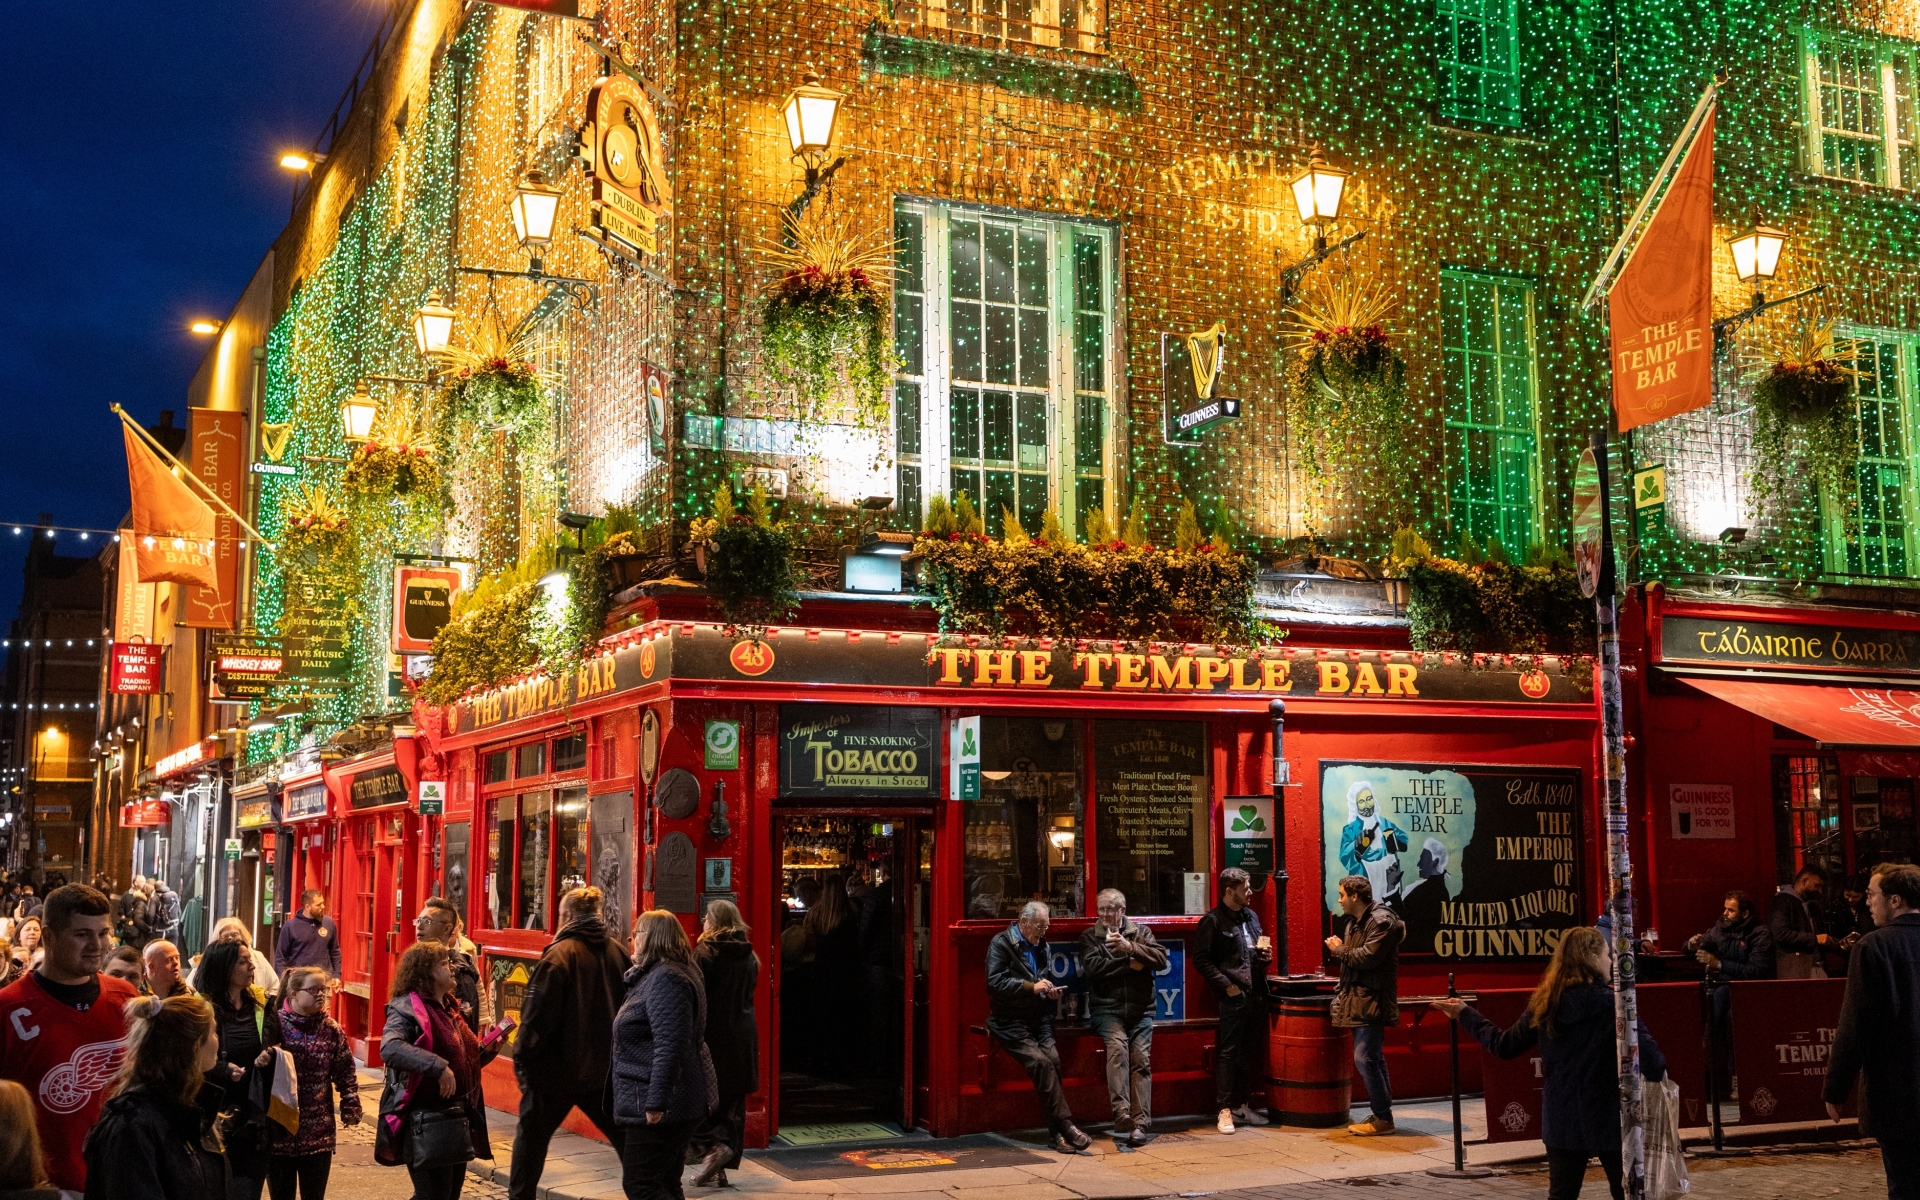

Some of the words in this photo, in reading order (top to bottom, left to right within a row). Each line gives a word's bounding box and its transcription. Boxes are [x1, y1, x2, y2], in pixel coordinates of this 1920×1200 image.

[600, 92, 612, 130] THE
[610, 81, 649, 120] TEMPLE
[648, 123, 659, 167] BAR
[613, 191, 646, 222] DUBLIN
[606, 213, 624, 234] LIVE
[627, 227, 652, 249] MUSIC
[1641, 320, 1678, 344] THE
[1619, 328, 1702, 373] TEMPLE
[1636, 361, 1678, 390] BAR
[1180, 402, 1219, 429] GUINNESS
[203, 442, 218, 477] BAR
[253, 463, 296, 474] GUINNESS
[222, 480, 232, 499] CO.
[166, 530, 197, 540] THE
[165, 552, 203, 566] BAR
[123, 582, 132, 624] TRADING
[410, 599, 445, 607] GUINNESS
[121, 626, 129, 641] CO.
[128, 646, 147, 654] THE
[236, 648, 269, 656] TEMPLE
[289, 650, 311, 658] LIVE
[313, 650, 344, 659] MUSIC
[118, 655, 156, 665] TEMPLE
[222, 658, 259, 670] WHISKEY
[259, 659, 282, 670] SHOP
[301, 660, 331, 668] DAILY
[125, 665, 146, 673] BAR
[227, 673, 276, 681] DISTILLERY
[929, 648, 1053, 688] THE
[1073, 652, 1293, 693] TEMPLE
[1316, 660, 1419, 697] BAR
[474, 697, 501, 727] THE
[506, 671, 570, 718] TEMPLE
[577, 658, 616, 699] BAR
[1523, 676, 1543, 692] 48
[787, 714, 851, 740] Importers
[844, 736, 867, 745] FINE
[869, 736, 917, 746] SMOKING
[1111, 740, 1166, 757] TEMPLE
[1170, 742, 1196, 759] BAR
[804, 741, 918, 782] TOBACCO
[1154, 755, 1169, 763] 1840
[828, 775, 870, 786] Always
[877, 776, 887, 785] in
[892, 775, 926, 786] Stock
[1119, 772, 1155, 780] Traditional
[1157, 772, 1174, 780] Food
[354, 781, 365, 800] THE
[365, 776, 387, 798] TEMPLE
[386, 773, 401, 793] BAR
[1131, 783, 1150, 791] Plate,
[1151, 783, 1176, 791] Cheese
[1409, 778, 1446, 797] THE
[1544, 783, 1573, 806] 1840
[1100, 794, 1118, 802] Fresh
[1120, 795, 1148, 804] Oysters,
[1149, 795, 1176, 803] Smoked
[1177, 795, 1203, 803] Salmon
[1672, 787, 1731, 804] GUINNESS
[1108, 806, 1147, 814] Charcuterie
[1149, 806, 1171, 814] Meats,
[1391, 796, 1464, 816] TEMPLE
[1695, 808, 1702, 816] IS
[1705, 807, 1729, 816] GOOD
[1118, 817, 1145, 825] Toasted
[1146, 817, 1185, 825] Sandwiches
[1411, 815, 1448, 834] BAR
[1537, 812, 1572, 835] THE
[1695, 818, 1711, 827] FOR
[1714, 818, 1730, 827] YOU
[1117, 828, 1130, 836] Hot
[1131, 828, 1150, 836] Roast
[1152, 828, 1169, 836] Beef
[1169, 828, 1187, 836] Rolls
[1495, 836, 1574, 862] EMPEROR
[1553, 863, 1573, 887] OF
[1440, 900, 1508, 927] MALTED
[1510, 888, 1578, 922] LIQUORS
[1434, 929, 1571, 958] GUINNES
[10, 1007, 40, 1041] C
[1817, 1028, 1837, 1042] TH
